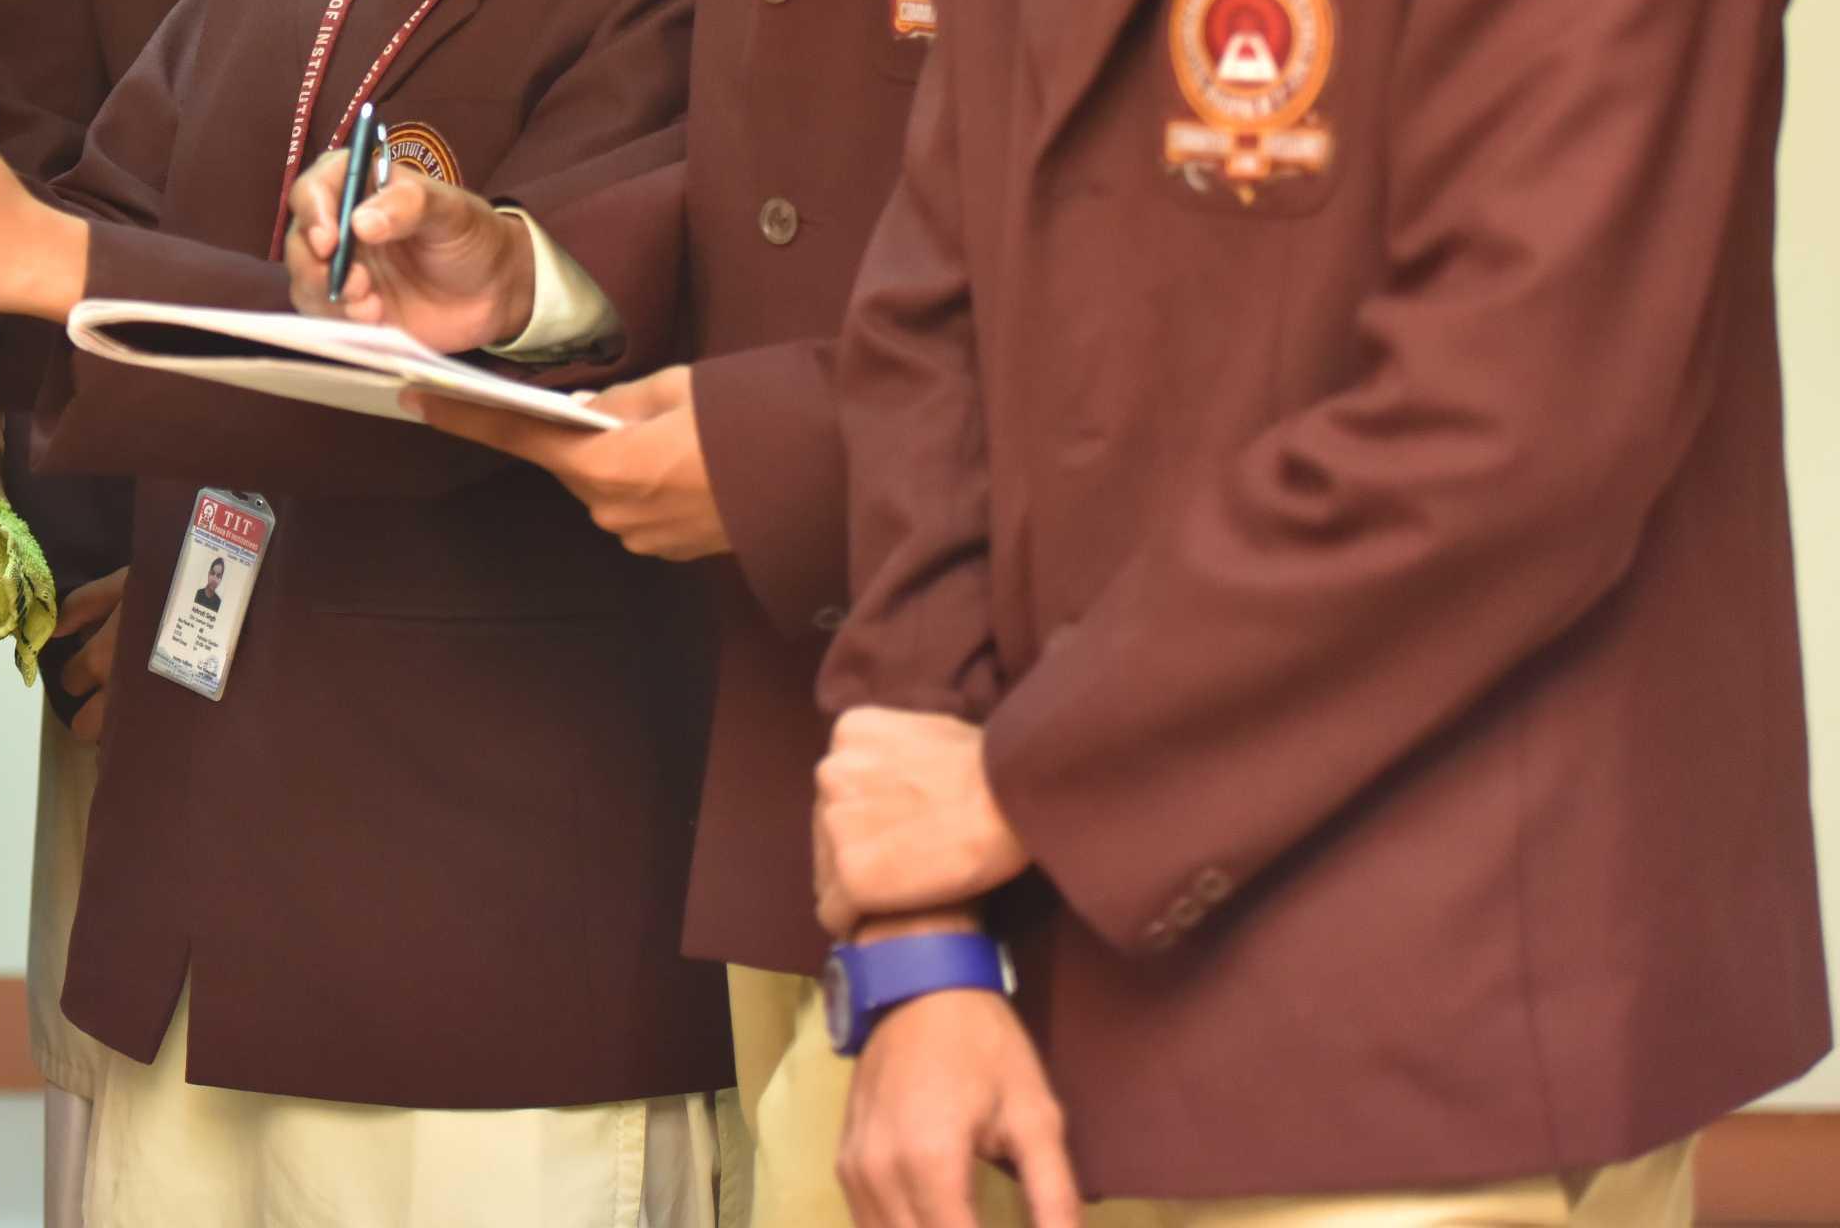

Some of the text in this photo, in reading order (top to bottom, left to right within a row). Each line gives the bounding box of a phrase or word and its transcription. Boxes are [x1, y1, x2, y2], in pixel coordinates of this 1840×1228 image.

[286, 25, 334, 166] INSTITUTIONS
[388, 141, 427, 162] STITUTE
[422, 153, 437, 170] OF
[223, 510, 254, 536] TIT
